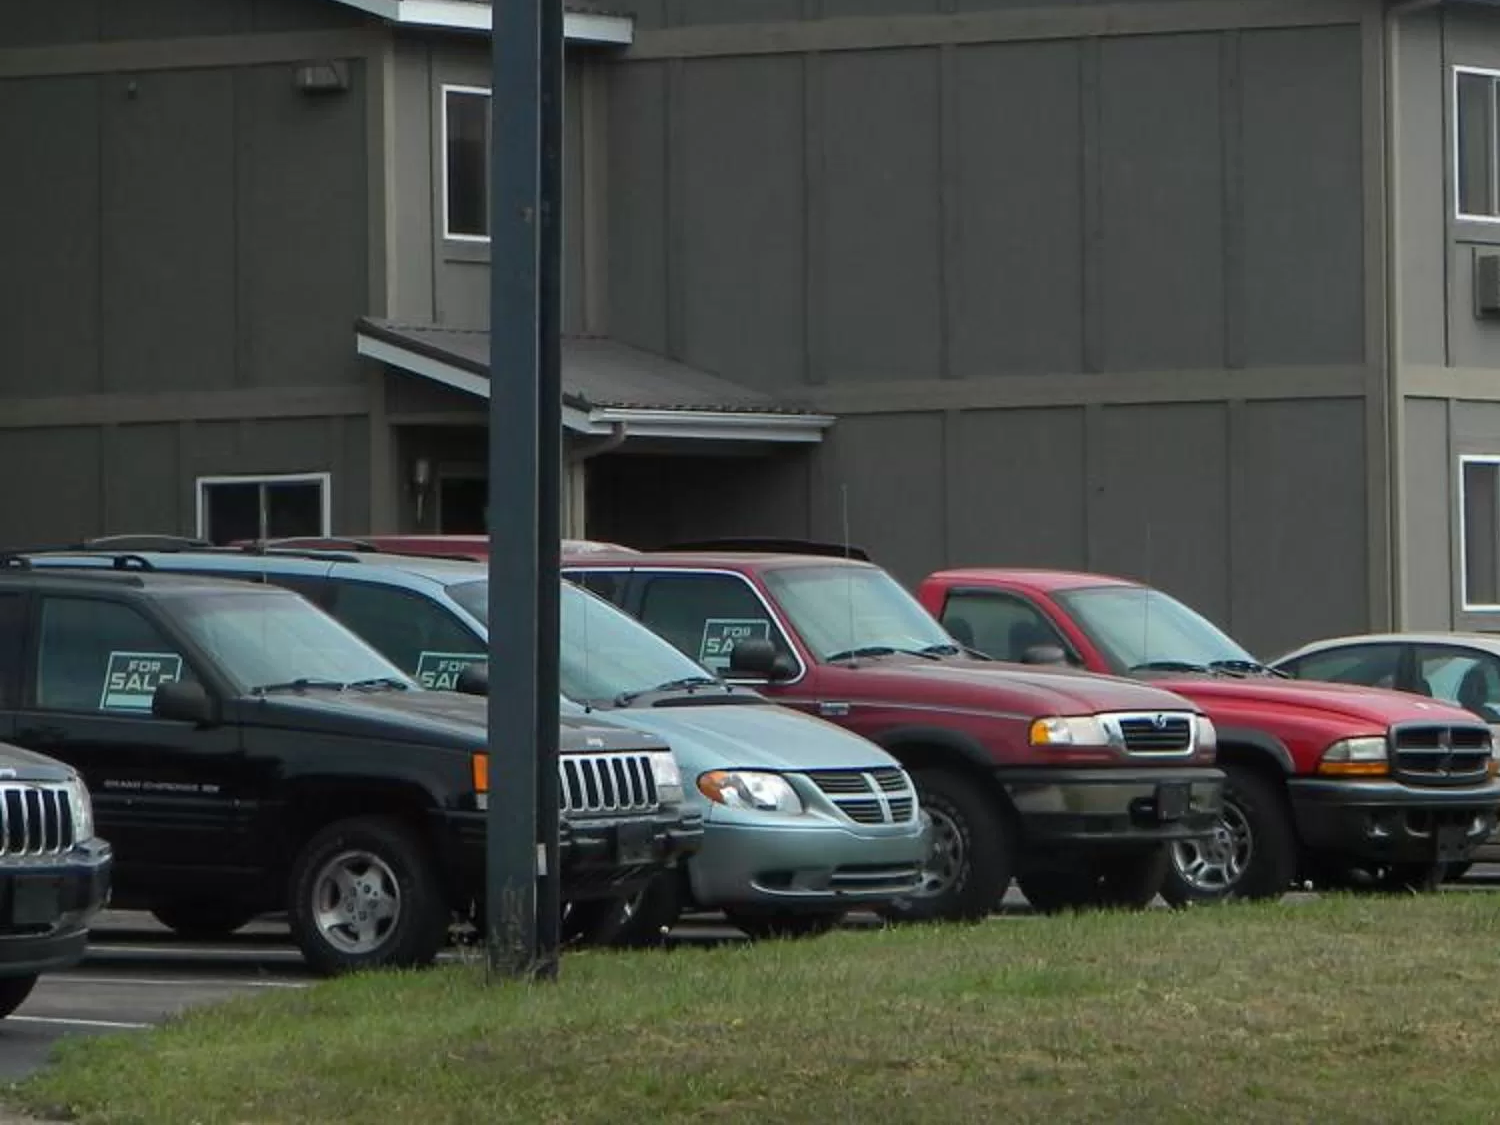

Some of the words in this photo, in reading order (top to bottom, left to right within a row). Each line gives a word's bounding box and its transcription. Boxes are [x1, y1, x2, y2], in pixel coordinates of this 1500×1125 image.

[722, 626, 751, 638] FOR
[127, 659, 161, 673] FOR
[421, 671, 461, 690] SAL
